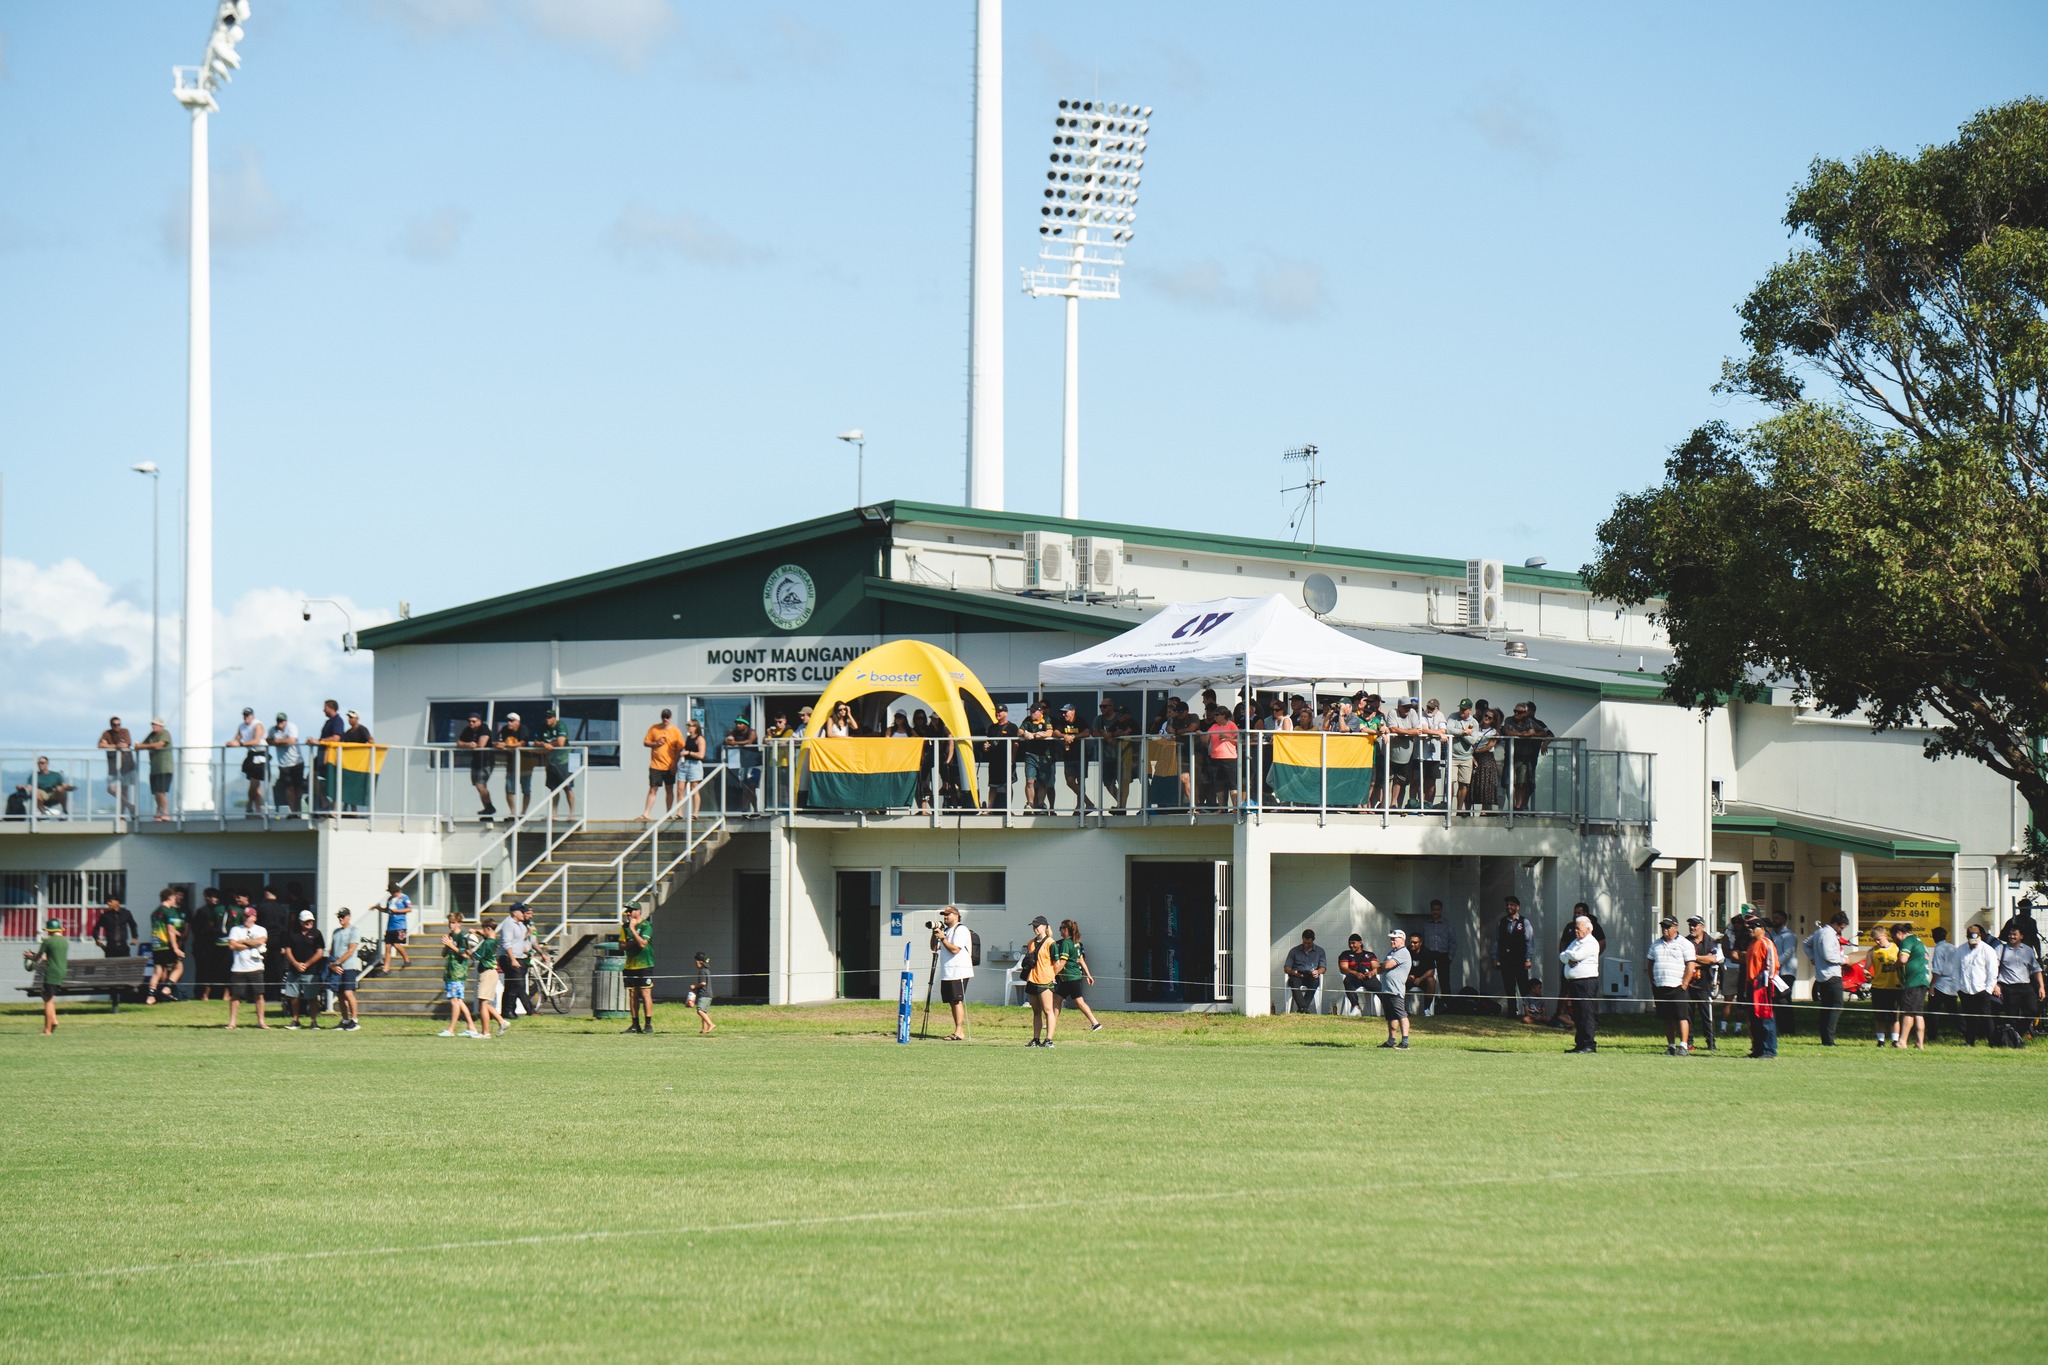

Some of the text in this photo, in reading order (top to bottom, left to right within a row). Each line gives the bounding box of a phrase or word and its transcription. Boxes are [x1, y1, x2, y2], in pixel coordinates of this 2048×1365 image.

[765, 566, 814, 599] MOUNT MAUNGANUI
[767, 607, 812, 628] SPORTS CLUB
[707, 649, 767, 664] MOUNT
[732, 667, 797, 682] SPORTS
[870, 671, 922, 682] booster
[1106, 663, 1176, 677] compoundwealth.co.nz
[1861, 900, 1901, 908] available
